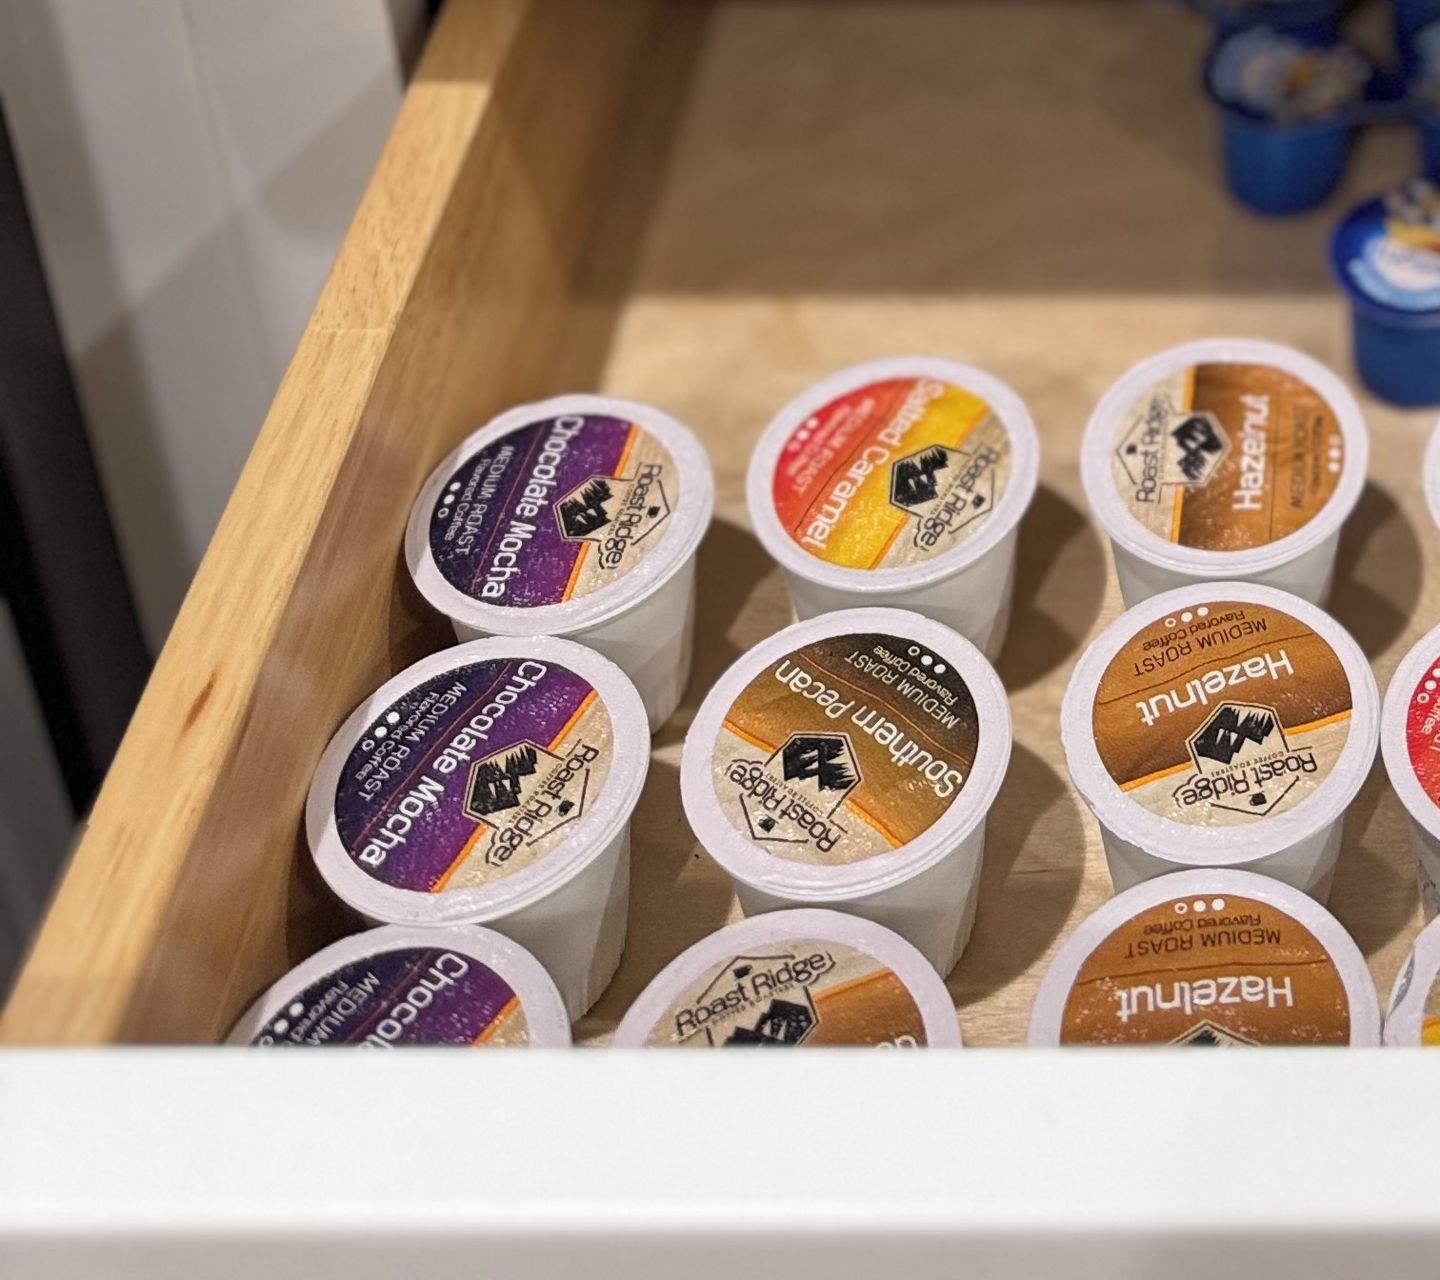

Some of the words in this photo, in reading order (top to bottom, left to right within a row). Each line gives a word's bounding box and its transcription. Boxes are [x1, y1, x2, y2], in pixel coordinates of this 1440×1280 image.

[878, 380, 942, 447] Salted
[479, 447, 511, 498] MEDIUM
[518, 416, 581, 518] Chocolate
[959, 447, 998, 495] Roast
[1136, 450, 1158, 501] Roast
[1233, 395, 1268, 507] Hazelnut
[627, 465, 660, 513] Roast
[800, 443, 887, 549] Caramel
[454, 502, 486, 555] ROAST
[606, 512, 639, 564] Ridge
[919, 494, 966, 547] Ridge
[481, 522, 533, 597] Mocha
[1142, 627, 1187, 651] Coffee
[1189, 609, 1244, 635] Flavored
[1197, 616, 1267, 649] MEDIUM
[845, 649, 897, 685] ROAST
[872, 644, 910, 673] Coffee
[1134, 641, 1190, 674] ROAST
[774, 659, 853, 720] Pecan
[898, 680, 958, 727] MEDIUM
[908, 667, 957, 704] Flavored
[1137, 649, 1292, 724] Hazelnut
[392, 692, 437, 741] Flavored
[407, 682, 465, 743] MEDIUM
[432, 659, 545, 774] Chocolate
[356, 739, 395, 781] Coffee
[359, 743, 408, 800] ROAST
[542, 743, 598, 802] Roast
[851, 705, 963, 796] Southern
[1252, 751, 1316, 786] Roast
[729, 765, 783, 812] Ridge
[1181, 771, 1248, 805] Ridge
[359, 775, 442, 866] Mocha
[494, 798, 551, 861] Ridge
[780, 799, 838, 853] Roast
[1124, 935, 1193, 959] ROAST
[1143, 918, 1194, 934] Coffee
[1197, 914, 1261, 930] Flavored
[1201, 928, 1281, 947] MEDIUM
[358, 953, 469, 1049] Chocol
[674, 983, 747, 1034] Roast
[751, 951, 824, 994] Ridge
[1115, 975, 1295, 1023] Hazelnut
